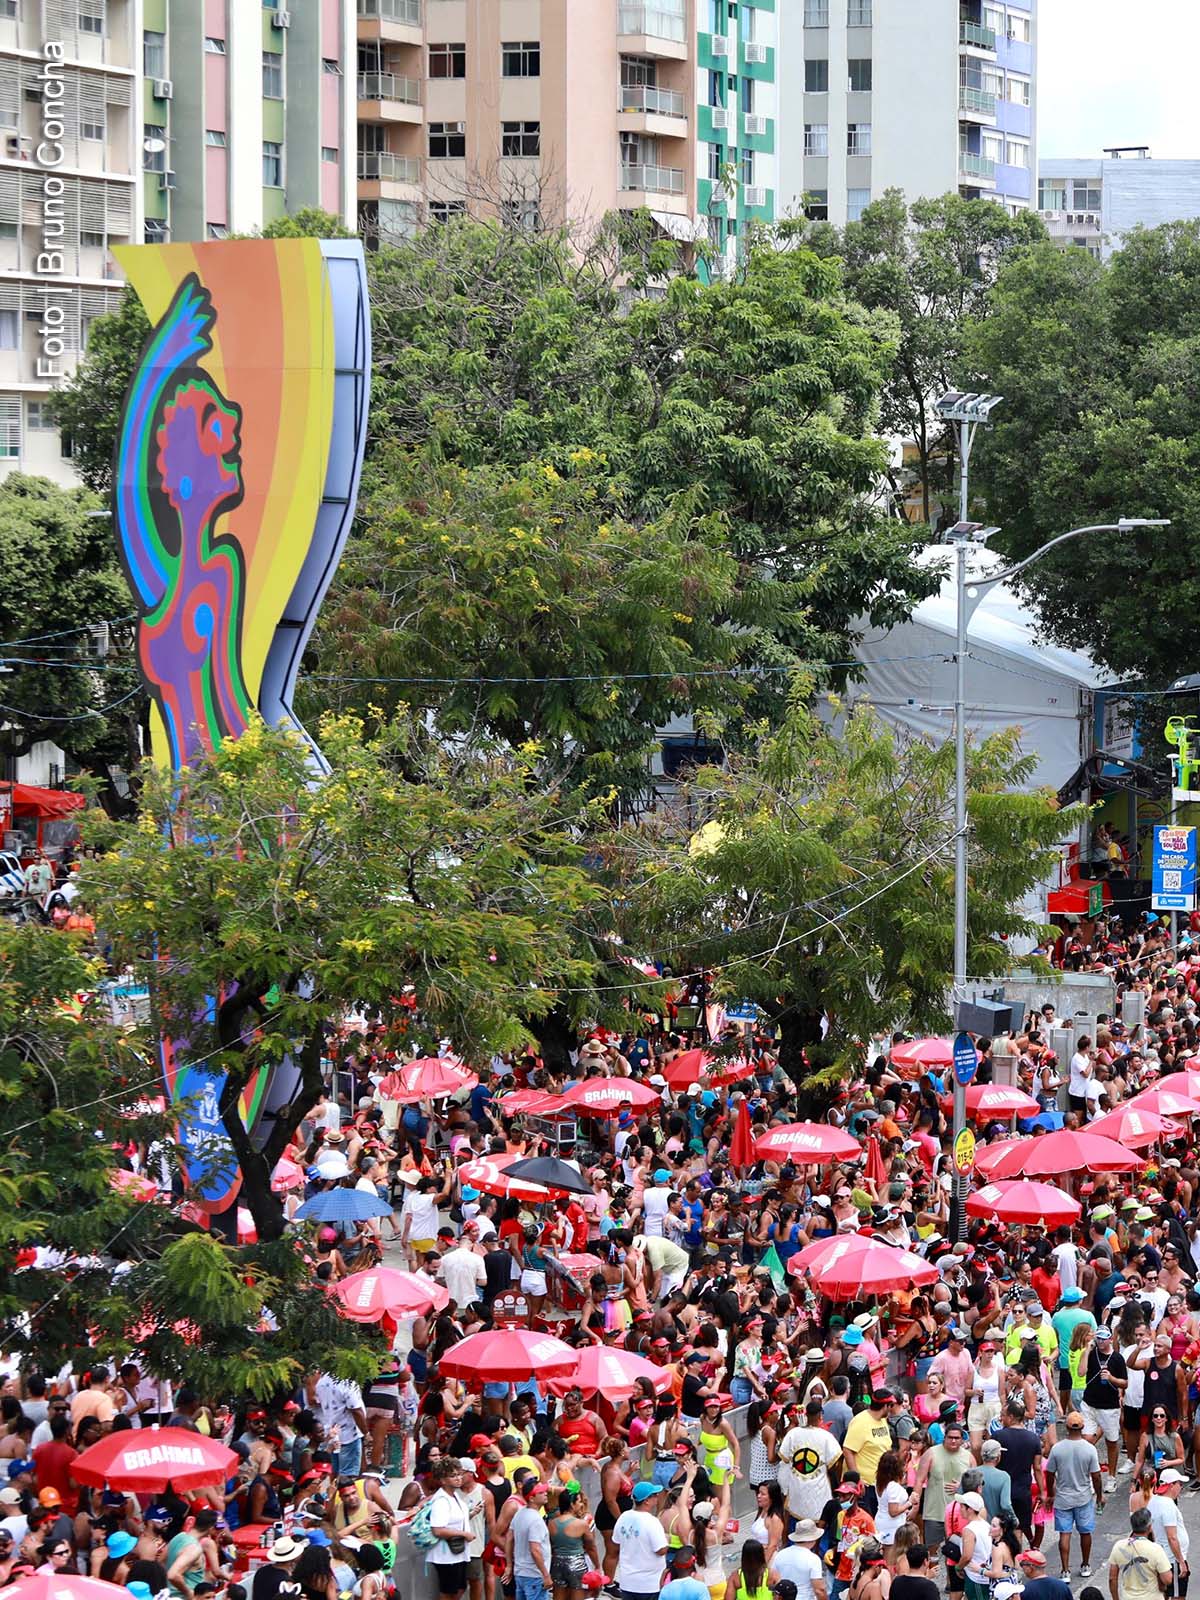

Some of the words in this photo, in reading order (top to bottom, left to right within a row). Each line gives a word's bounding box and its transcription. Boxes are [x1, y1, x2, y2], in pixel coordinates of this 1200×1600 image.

[585, 1088, 633, 1103] BRAHMA
[770, 1131, 823, 1149] BRAHMA
[123, 1445, 205, 1470] BRAHMA
